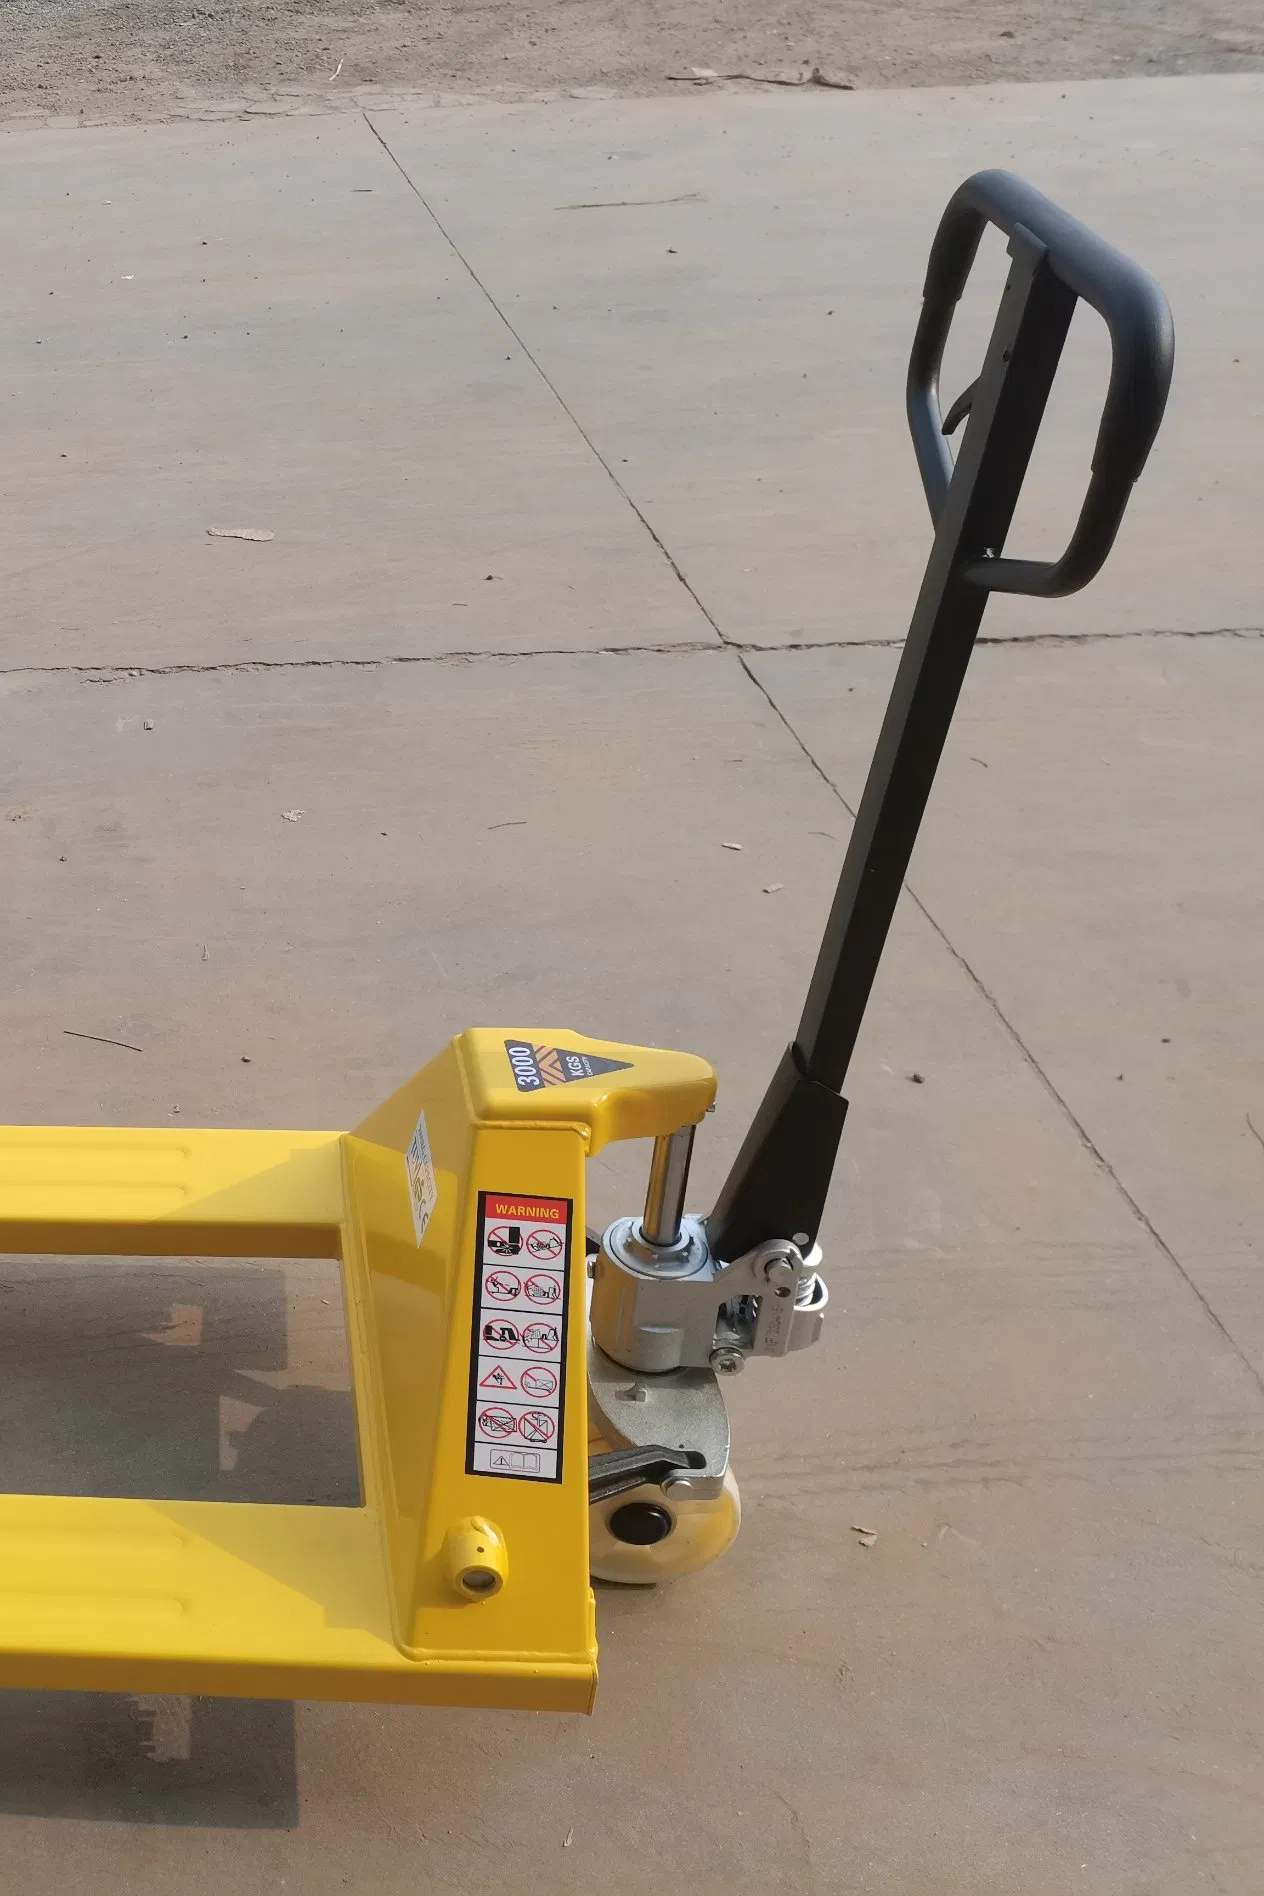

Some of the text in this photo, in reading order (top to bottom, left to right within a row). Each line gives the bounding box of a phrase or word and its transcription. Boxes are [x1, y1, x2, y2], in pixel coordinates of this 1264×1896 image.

[508, 1046, 540, 1086] 3000
[566, 1056, 584, 1076] KGS
[495, 1203, 559, 1219] WARNING
